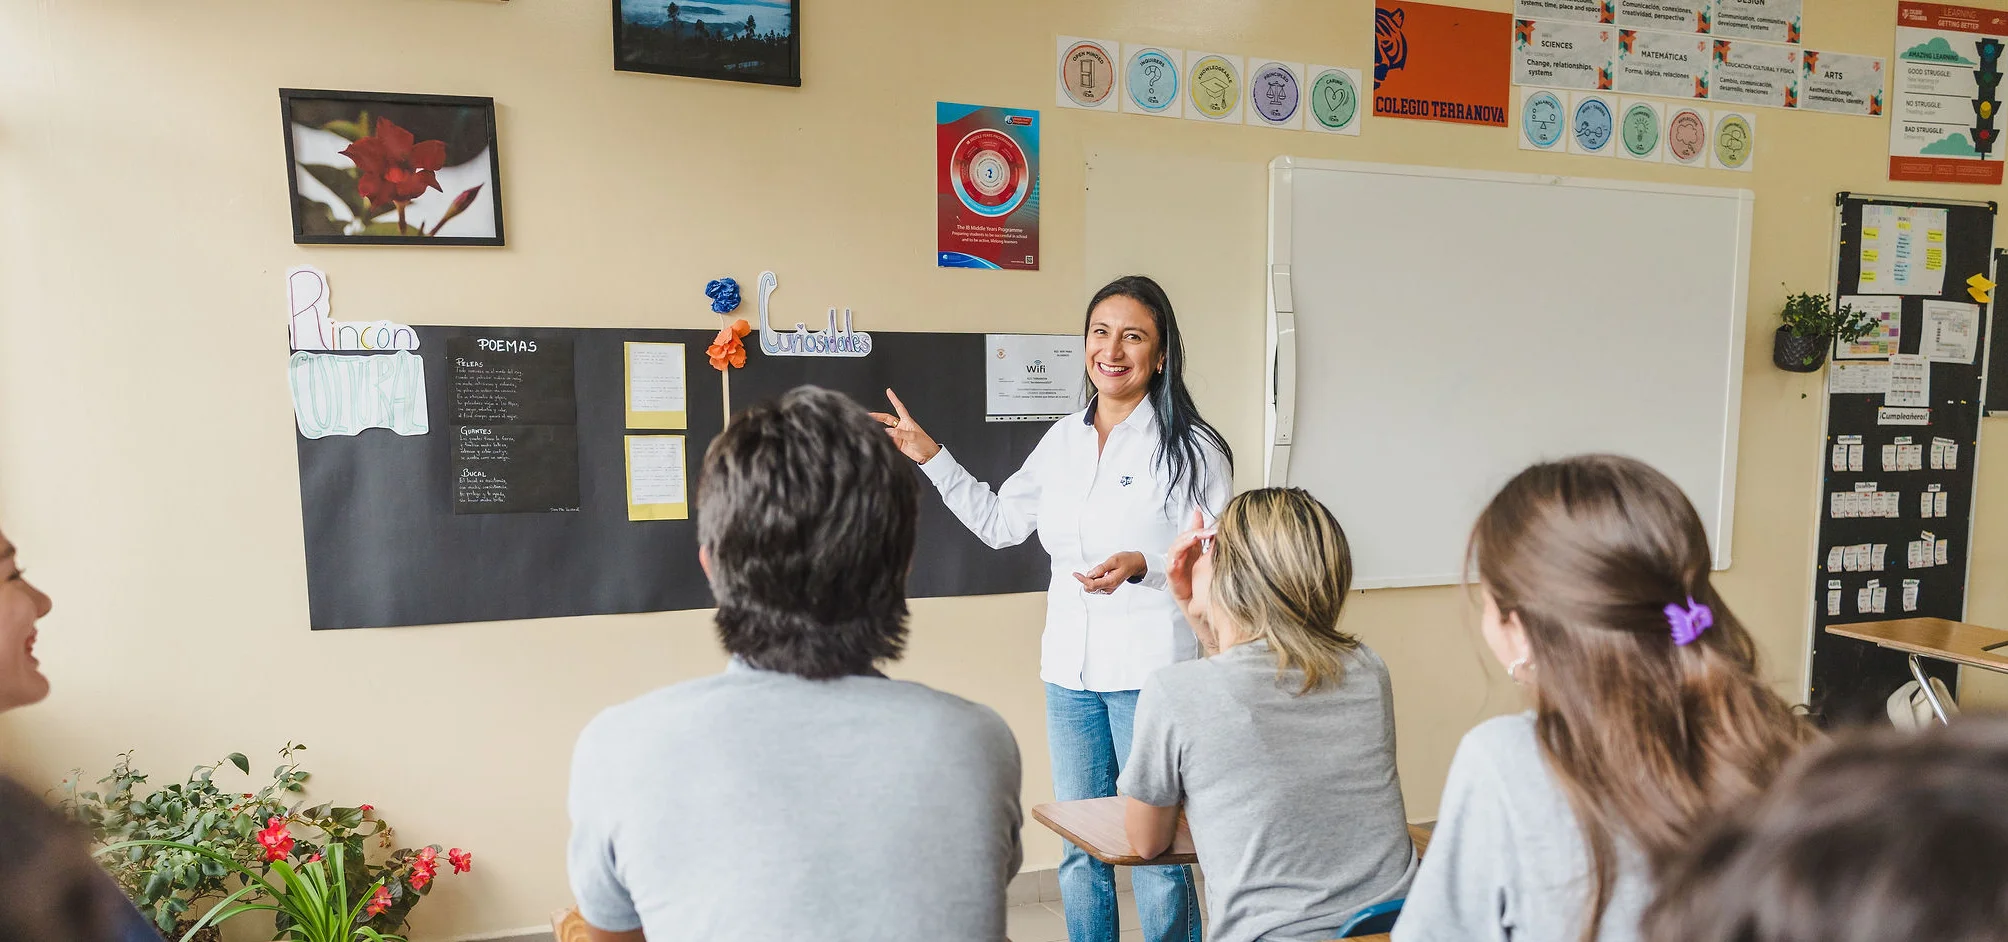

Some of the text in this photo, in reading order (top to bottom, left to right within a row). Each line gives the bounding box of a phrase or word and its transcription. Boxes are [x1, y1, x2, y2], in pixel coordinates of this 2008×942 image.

[1622, 1, 1692, 14] Comunicación, conexiones,
[1622, 10, 1653, 18] creatividad,
[1718, 12, 1755, 22] Communication,
[1943, 8, 1977, 19] LEARNING
[1717, 21, 1749, 29] development,
[1938, 19, 1979, 30] GETTING BETTER
[1541, 40, 1573, 49] SCIENCES
[1072, 51, 1104, 65] OPEN MINDED
[1641, 50, 1688, 62] MATEMÁTICAS
[1933, 53, 1958, 61] LEARNING
[1140, 58, 1165, 68] INQUIRERS
[1527, 59, 1594, 71] Change, relationships,
[1753, 64, 1775, 72] CULTURAL
[1198, 65, 1233, 84] KNOWLEDGEABLE
[1263, 71, 1289, 83] PRINCIPLED
[1625, 68, 1689, 79] Forma, lógica, relaciones
[1824, 71, 1843, 80] ARTS
[1924, 69, 1951, 77] STRUGGLE:
[1719, 77, 1773, 88] Cambio, comunicación,
[1719, 85, 1744, 93] desarrollo,
[1809, 86, 1853, 98] Aesthetics, change,
[1535, 100, 1555, 109] BALANCED
[1808, 95, 1864, 106] communication, identity
[1915, 101, 1942, 109] STRUGGLE:
[1375, 96, 1505, 123] COLEGIO TERRANOVA
[290, 271, 412, 350] Rincón
[759, 272, 871, 354] Curiosidades
[477, 338, 537, 353] POEMAS
[456, 357, 484, 367] PELEAS
[1026, 364, 1046, 373] Wifi
[290, 351, 428, 437] CULTURAL
[1879, 412, 1928, 421] ¡Cumpleañeros!
[460, 468, 487, 478] BUCAL
